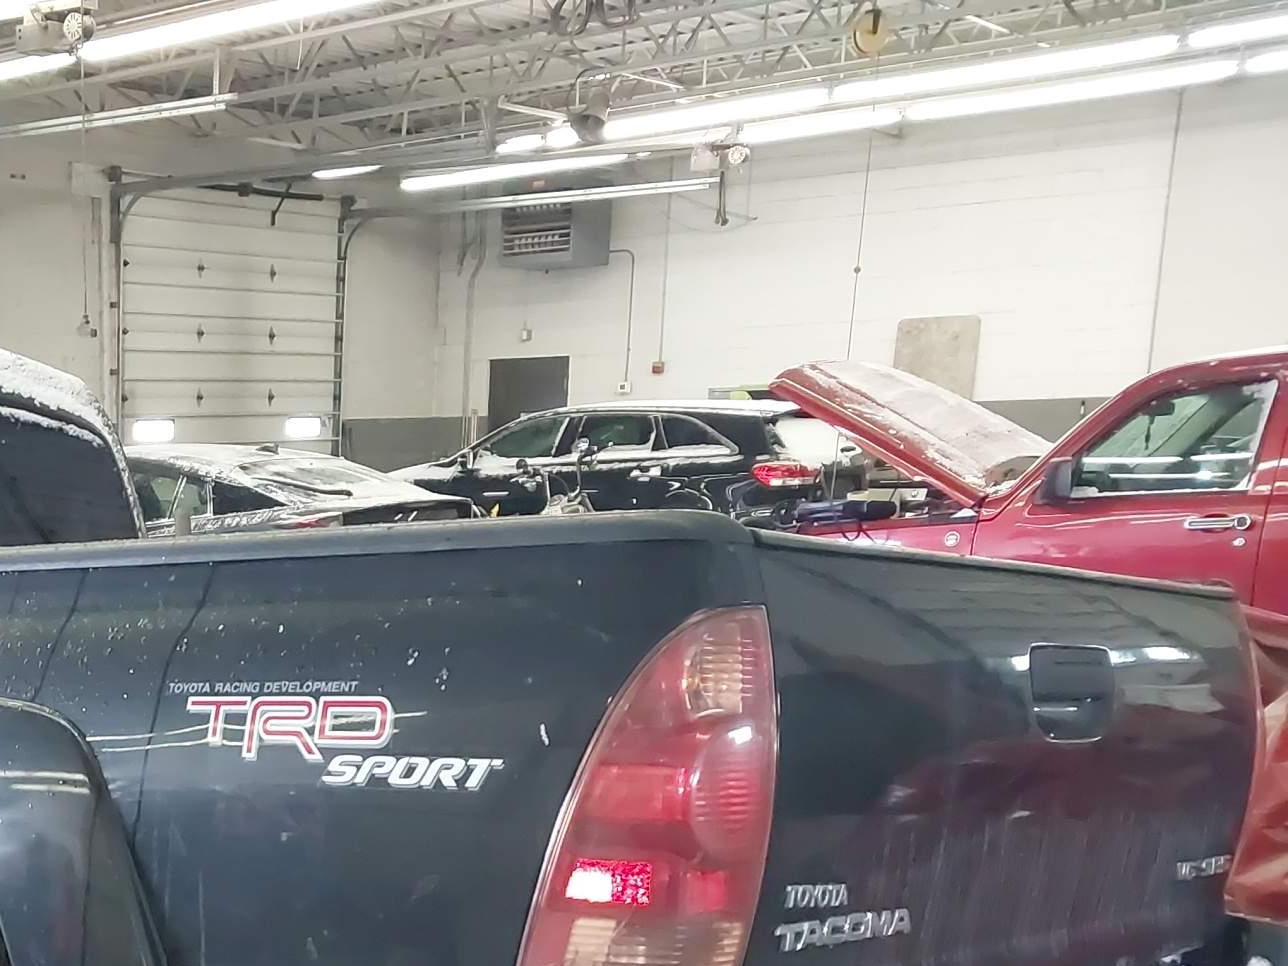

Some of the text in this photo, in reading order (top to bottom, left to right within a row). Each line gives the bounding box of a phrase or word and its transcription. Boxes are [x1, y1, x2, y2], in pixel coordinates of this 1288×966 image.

[168, 680, 359, 694] TOYOTA RACING DEVELOPMENT
[186, 696, 392, 762] TRD
[321, 755, 505, 790] SPORT
[784, 884, 848, 908] TOYOTA
[773, 908, 911, 951] TACOMA
